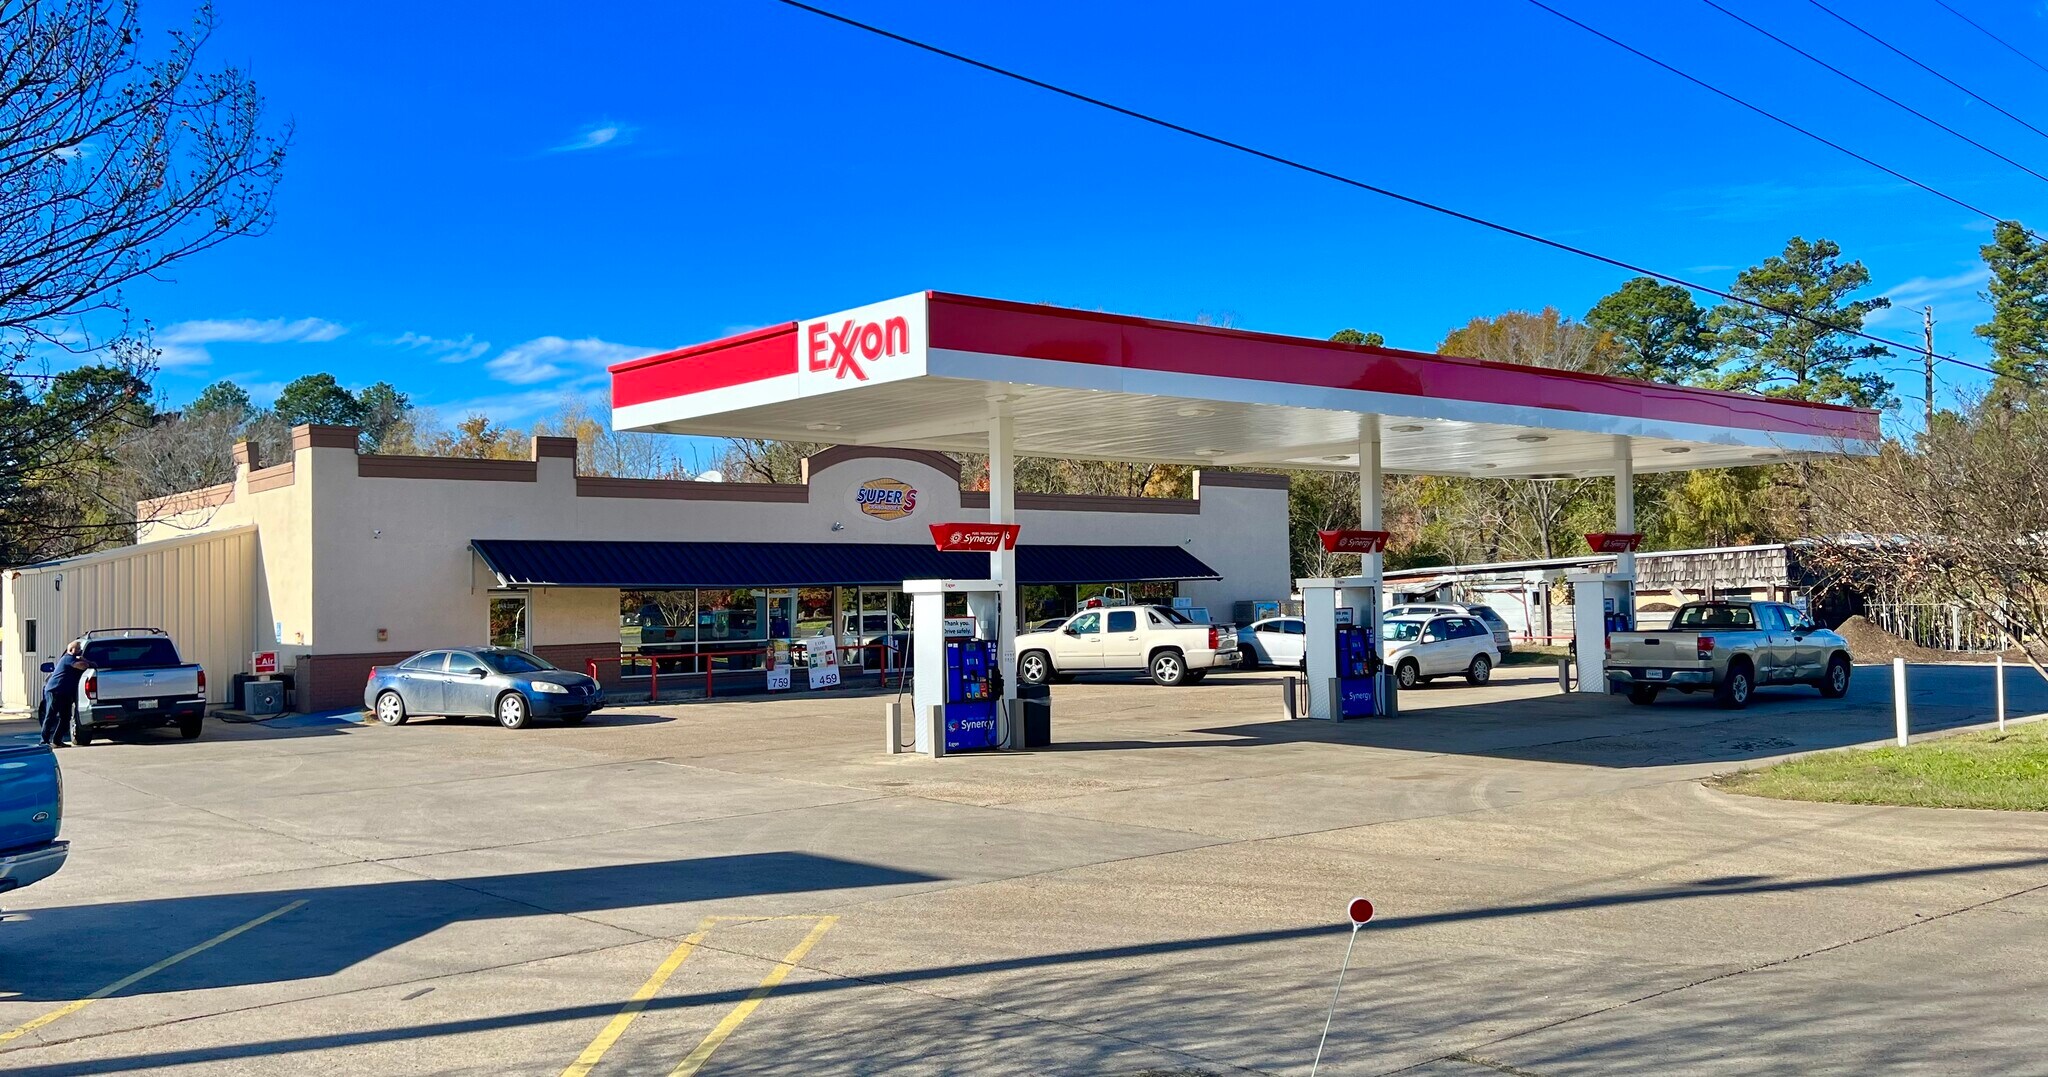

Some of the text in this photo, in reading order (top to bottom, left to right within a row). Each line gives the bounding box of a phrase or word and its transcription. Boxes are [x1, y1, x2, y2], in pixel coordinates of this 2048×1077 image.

[808, 316, 910, 381] Exxon
[856, 488, 918, 512] SUPER S
[963, 533, 998, 545] Synergy
[1005, 531, 1010, 539] 6
[1347, 538, 1372, 548] Synergy
[262, 657, 274, 665] Air
[772, 677, 789, 688] 759
[819, 673, 837, 685] 459
[1349, 691, 1372, 701] Synergy
